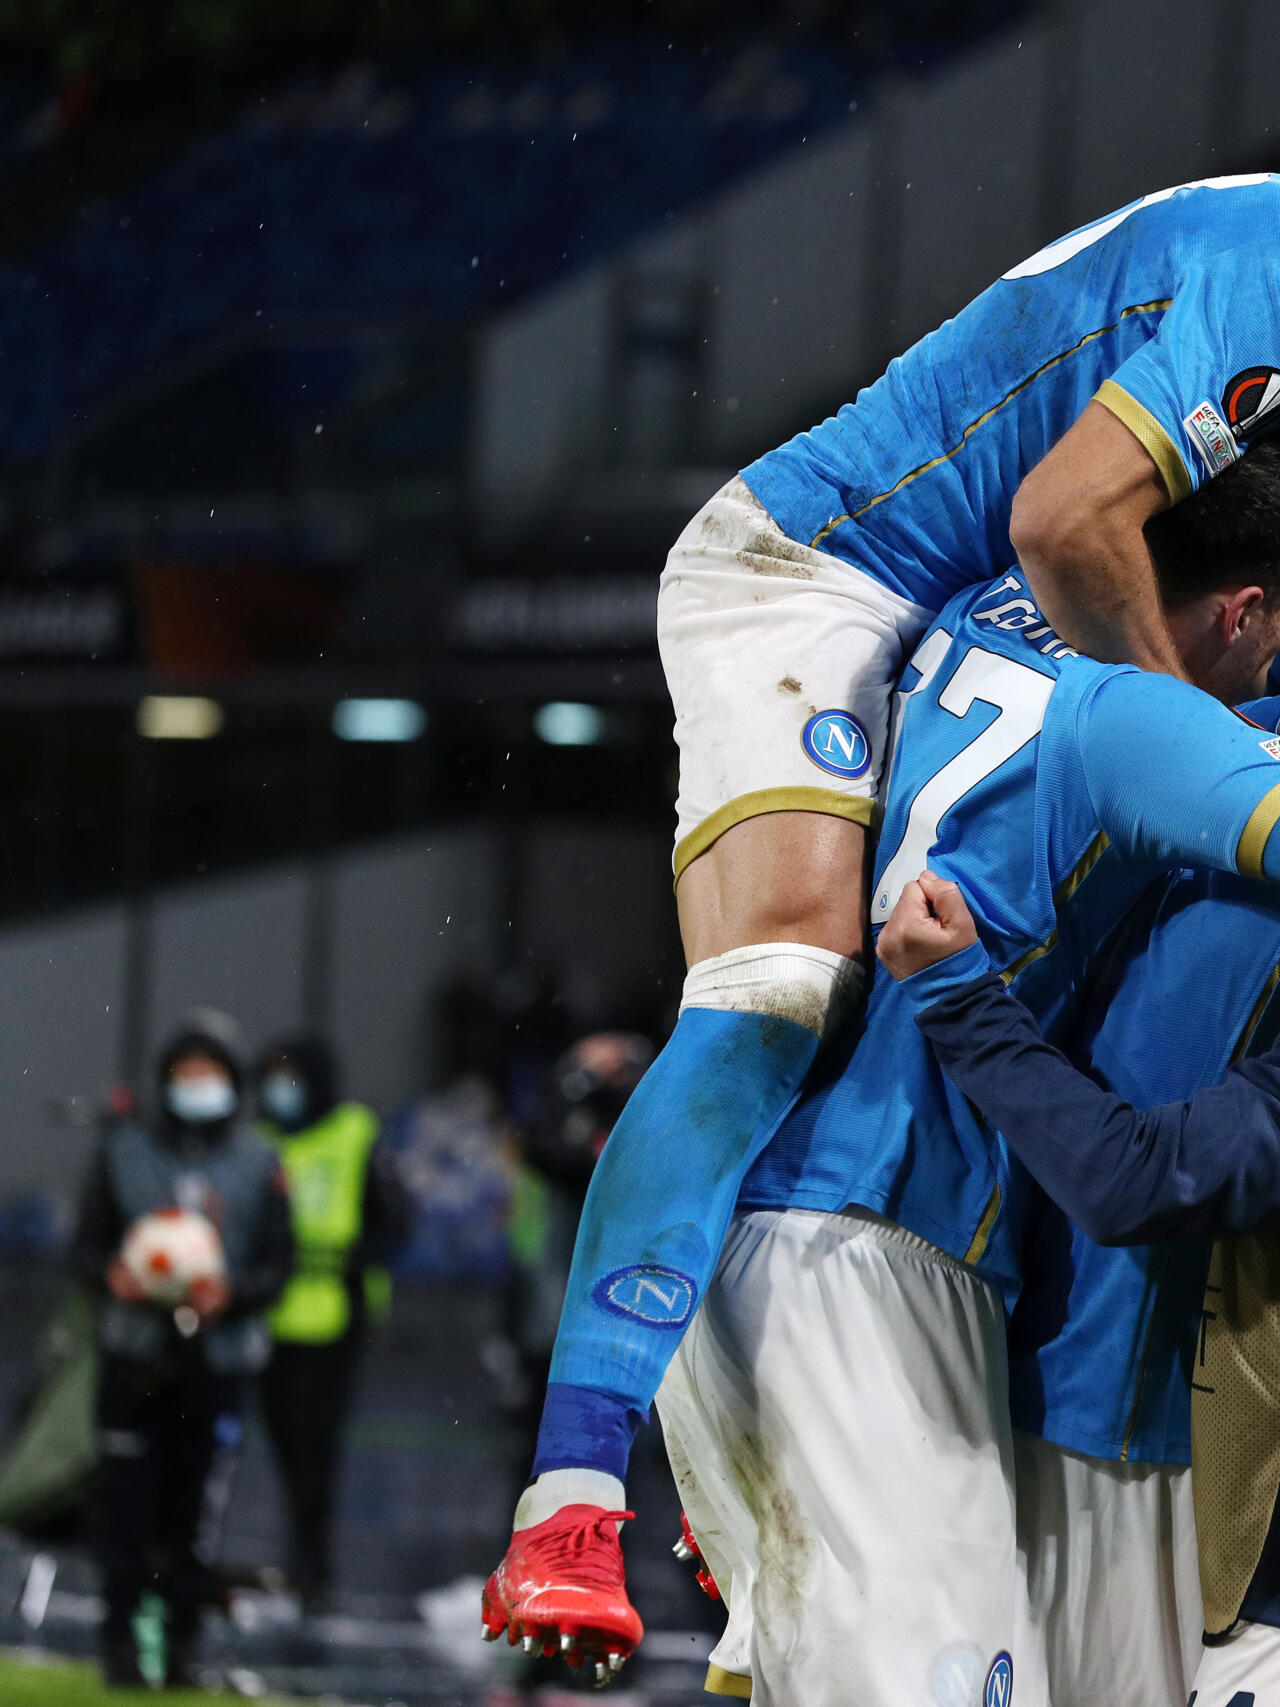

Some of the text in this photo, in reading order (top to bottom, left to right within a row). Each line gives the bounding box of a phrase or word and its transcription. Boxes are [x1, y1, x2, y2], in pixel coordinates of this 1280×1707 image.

[1201, 405, 1221, 428] UEFA
[1193, 411, 1232, 468] FOUNDAT
[822, 722, 859, 761] N
[628, 1278, 684, 1311] N
